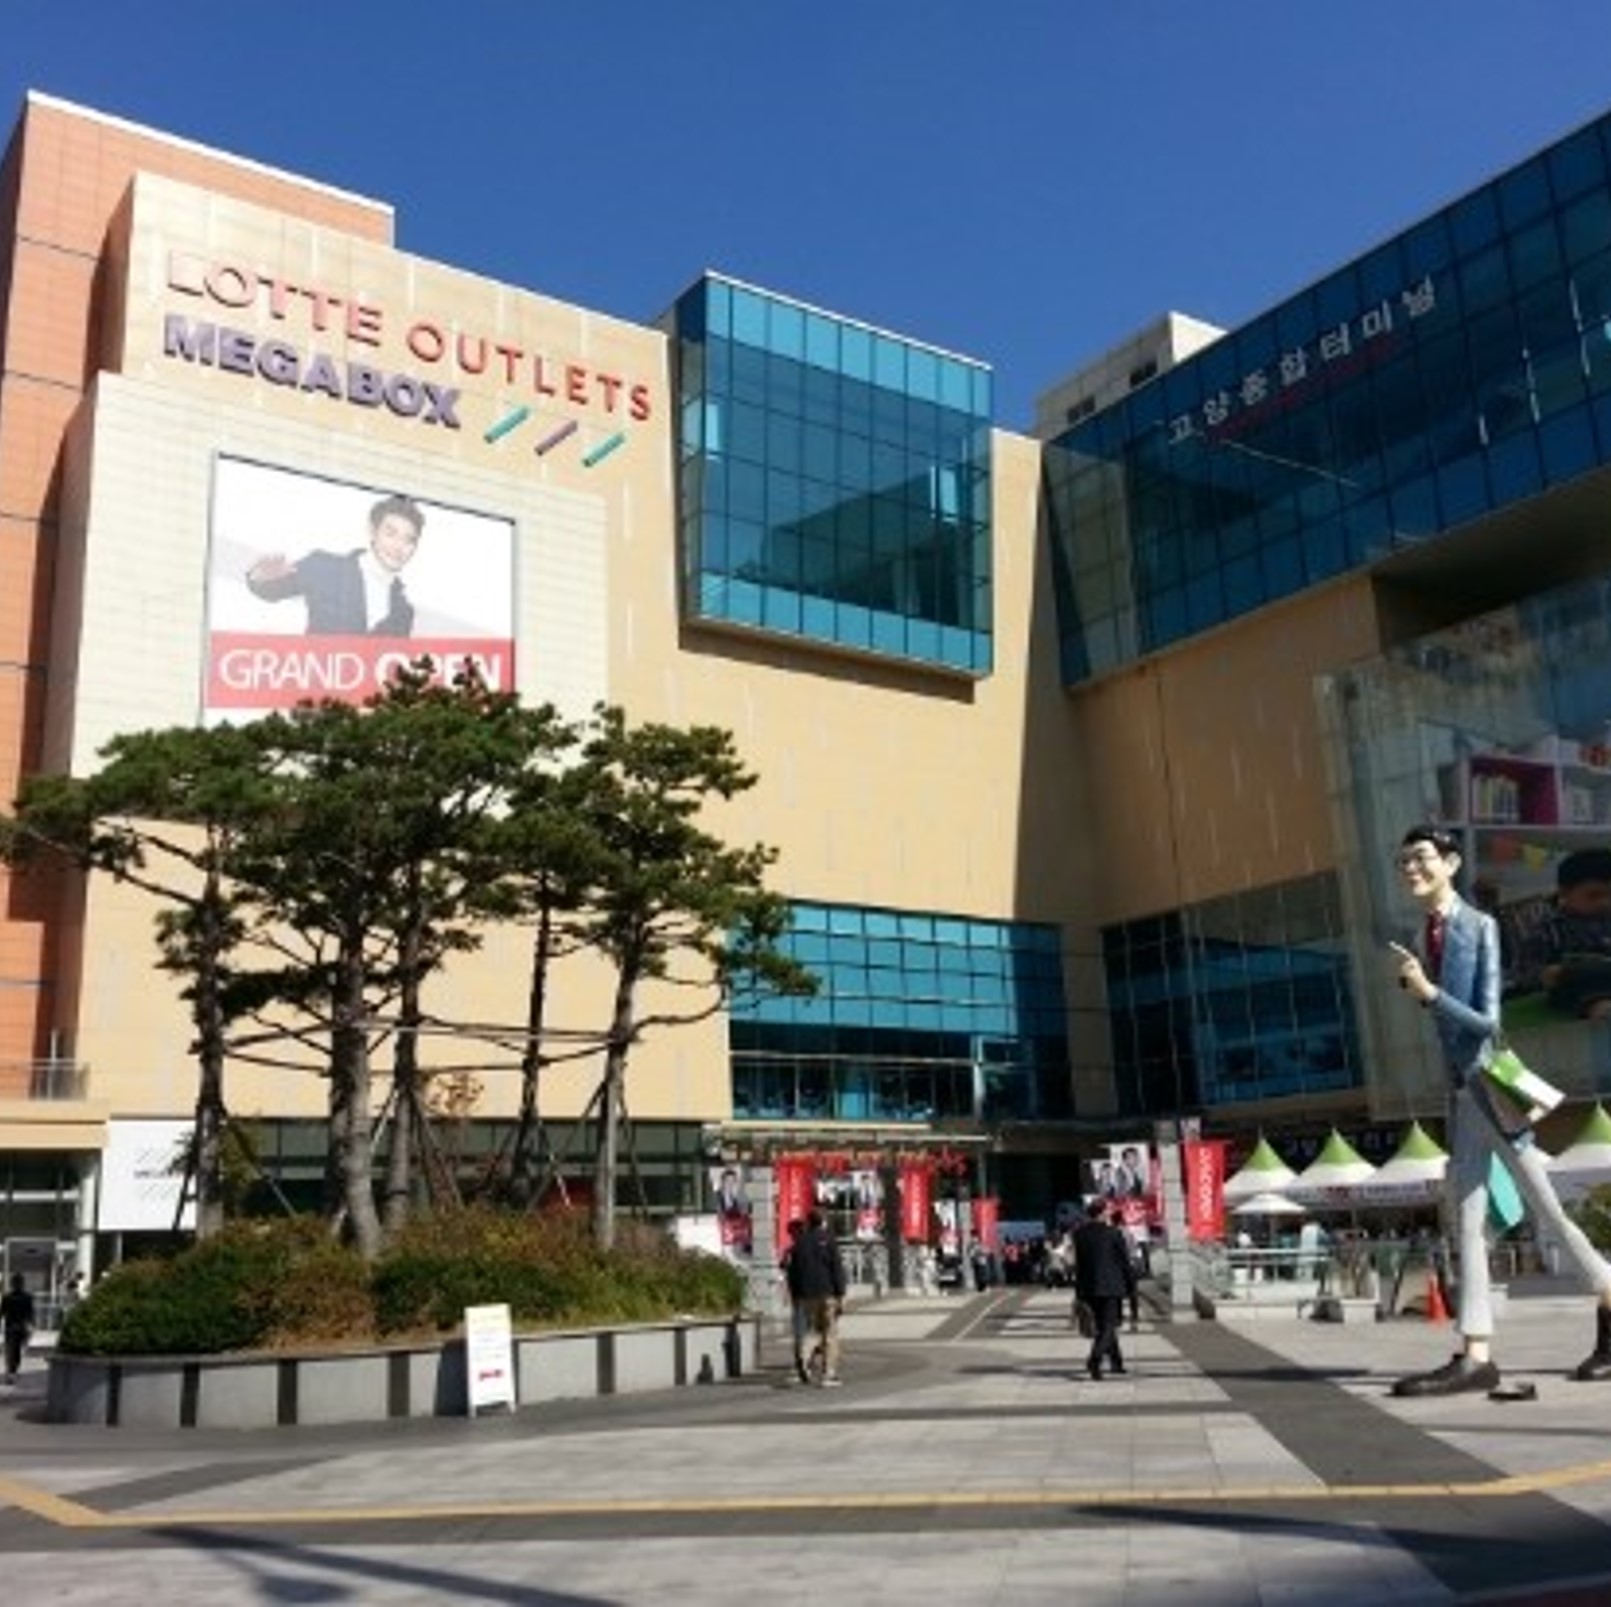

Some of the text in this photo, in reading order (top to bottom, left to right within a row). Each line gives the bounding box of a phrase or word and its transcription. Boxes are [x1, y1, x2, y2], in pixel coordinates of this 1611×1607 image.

[163, 311, 462, 430] MEGABOX
[166, 249, 653, 422] LOTTE OUTLETS
[218, 648, 364, 692] GRAND
